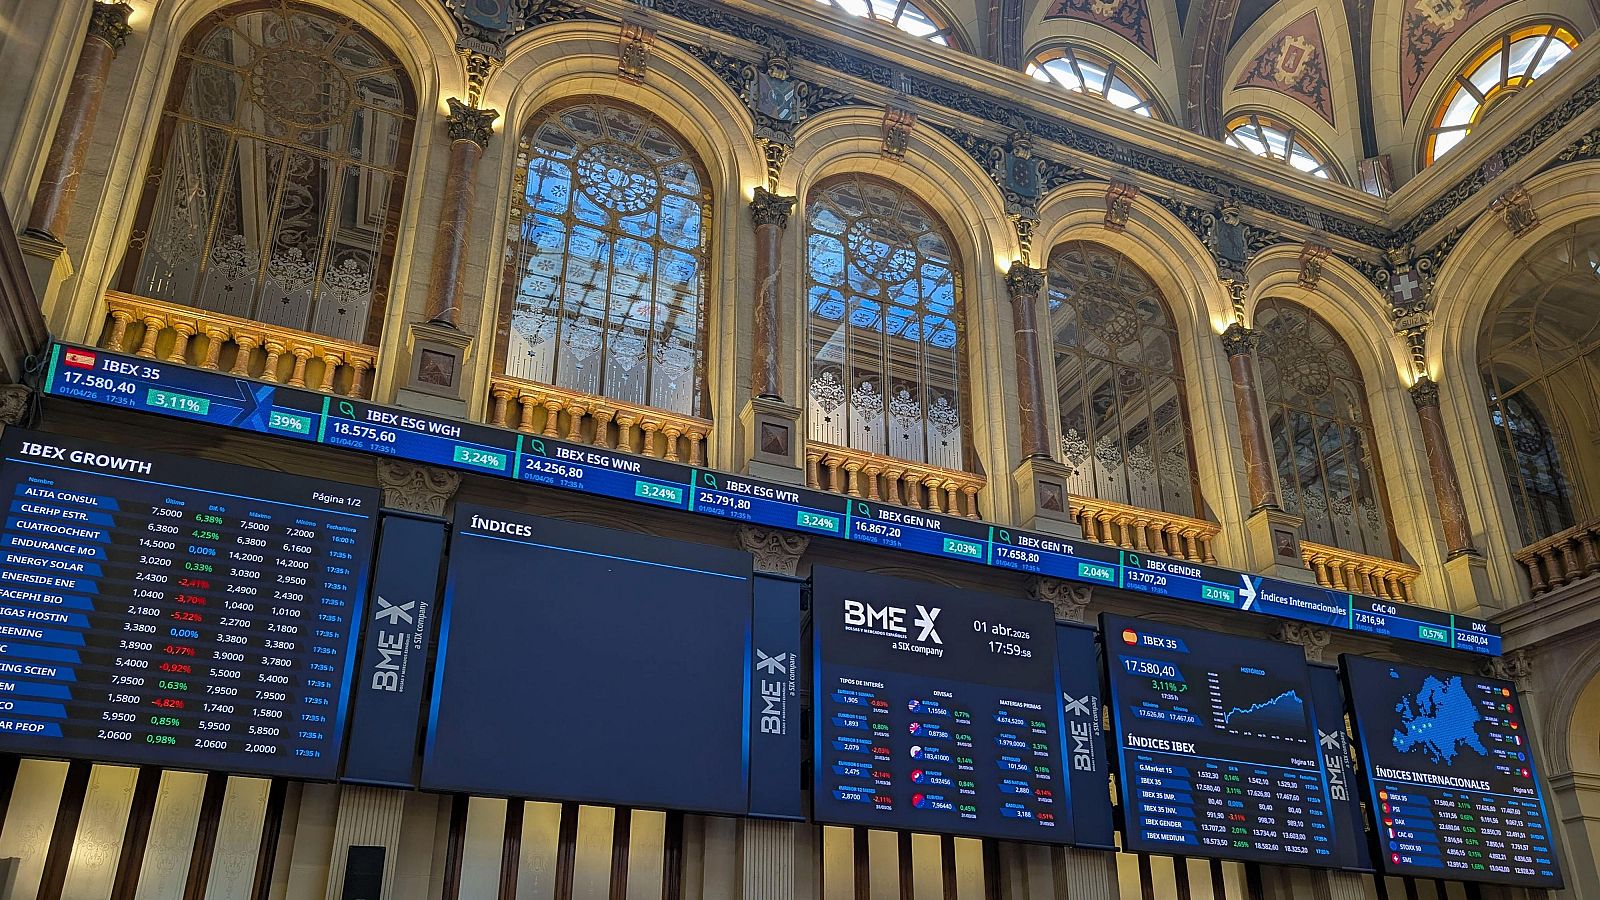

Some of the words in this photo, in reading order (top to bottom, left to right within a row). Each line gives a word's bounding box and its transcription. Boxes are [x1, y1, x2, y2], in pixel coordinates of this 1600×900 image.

[102, 359, 138, 376] IBEX
[141, 367, 161, 380] 35
[64, 371, 136, 394] 17.580,40
[60, 386, 98, 400] 01/04/26
[105, 394, 128, 405] 17:35
[156, 393, 200, 412] 3,11%
[366, 409, 398, 426] IBEX
[400, 418, 426, 431] ESG
[428, 422, 461, 438] WGH
[333, 422, 396, 443] 18.575,60
[330, 436, 363, 448] 01/04/26
[370, 443, 389, 453] 17:35
[20, 441, 67, 461] IBEX
[70, 450, 152, 475] GROWTH
[461, 450, 499, 466] 3,24%
[556, 447, 585, 462] IBEX
[587, 454, 609, 466] ESG
[611, 458, 641, 473] WNR
[526, 459, 583, 479] 24.256,80
[28, 476, 54, 486] Nombre
[524, 472, 554, 484] 01/04/26
[25, 487, 55, 499] ALTIA
[57, 492, 98, 506] CONSUL
[641, 484, 676, 500] 3,24%
[726, 480, 752, 494] IBEX
[753, 486, 774, 498] ESG
[775, 490, 800, 503] WTR
[312, 492, 344, 505] Página
[346, 498, 362, 507] 1/2
[700, 492, 751, 510] 25.791,80
[21, 504, 61, 516] CLERHP
[62, 510, 89, 521] ESTR.
[152, 507, 183, 518] 7,5000
[195, 513, 223, 525] 6,38%
[240, 520, 270, 532] 7,5000
[470, 514, 532, 537] ÍNDICES
[802, 515, 834, 529] 3,24%
[878, 509, 901, 522] IBEX
[903, 514, 924, 526] GEN
[926, 519, 941, 530] NR
[16, 520, 100, 539] CUATROOCHENT
[147, 523, 179, 534] 6,3800
[855, 521, 901, 538] 16.867,20
[192, 530, 220, 541] 4,25%
[11, 537, 76, 554] ENDURANCE
[77, 546, 96, 556] MO
[139, 538, 175, 550] 14,5000
[188, 545, 217, 556] 0,00%
[283, 543, 312, 554] 6,1600
[948, 541, 977, 555] 2,03%
[1018, 536, 1040, 549] IBEX
[1041, 541, 1060, 552] GEN
[1061, 544, 1074, 555] TR
[139, 555, 172, 567] 3,0200
[229, 551, 264, 563] 14,2000
[996, 547, 1040, 563] 17.658,80
[6, 554, 49, 568] ENERGY
[49, 560, 84, 572] SOLAR
[185, 562, 213, 573] 0,33%
[1146, 560, 1167, 572] IBEX
[1168, 564, 1202, 578] GENDER
[135, 572, 168, 583] 2,4300
[1083, 566, 1110, 579] 2,04%
[1127, 571, 1167, 586] 13.707,20
[1, 571, 53, 585] ENERSIDE
[55, 578, 76, 588] ENE
[43, 594, 63, 604] BIO
[132, 589, 164, 600] 1,0400
[273, 591, 304, 602] 2,4300
[1206, 588, 1230, 600] 2,01%
[1260, 589, 1289, 605] Índices
[1289, 596, 1347, 616] Internacionales
[1371, 602, 1386, 613] CAC
[1387, 605, 1396, 615] 40
[27, 610, 69, 623] HOSTIN
[128, 605, 161, 617] 2,1800
[417, 601, 429, 632] company
[844, 599, 907, 633] BME
[220, 617, 251, 628] 2,2700
[1355, 613, 1386, 626] 7.816,94
[123, 622, 157, 634] 3,3800
[973, 620, 987, 633] 01
[1472, 622, 1487, 633] DAX
[170, 628, 199, 639] 0,00%
[414, 633, 423, 644] SIX
[1422, 629, 1444, 640] 0,57%
[1457, 632, 1489, 646] 22.680,04
[119, 640, 153, 651] 3,8900
[1143, 635, 1164, 647] IBEX
[1166, 640, 1177, 649] 35
[898, 641, 911, 651] SIX
[911, 644, 944, 657] company
[115, 657, 149, 669] 5,4000
[261, 656, 292, 668] 3,7800
[372, 630, 404, 692] BME
[789, 652, 797, 681] company
[0, 663, 22, 673] ING
[24, 665, 56, 677] SCIEN
[159, 663, 192, 674] -0,92%
[209, 668, 241, 679] 5,5000
[1125, 660, 1175, 677] 17.580,40
[111, 675, 145, 686] 7,9500
[158, 680, 188, 691] 0,63%
[863, 681, 884, 689] INTERÉS
[1152, 680, 1177, 692] 3,11%
[107, 694, 140, 704] 1,5800
[933, 690, 953, 698] DIVISAS
[151, 699, 185, 709] -4,82%
[761, 679, 781, 735] BME
[999, 700, 1023, 709] MATERIAS
[102, 711, 136, 722] 5,9500
[150, 716, 180, 727] 0,85%
[15, 722, 45, 732] PEOP
[249, 726, 280, 736] 5,8500
[97, 730, 132, 741] 2,0600
[146, 734, 176, 745] 0,98%
[194, 739, 227, 750] 2,0600
[1070, 720, 1092, 771] BME
[1128, 733, 1170, 750] ÍNDICES
[1172, 741, 1196, 754] IBEX
[1139, 764, 1165, 773] G.Market
[1325, 754, 1347, 801] BME
[1376, 765, 1412, 781] ÍNDICES
[1412, 772, 1490, 791] INTERNACIONALES
[1159, 820, 1182, 828] GENDER
[1147, 832, 1160, 840] IBEX
[1160, 833, 1185, 842] MEDIUM
